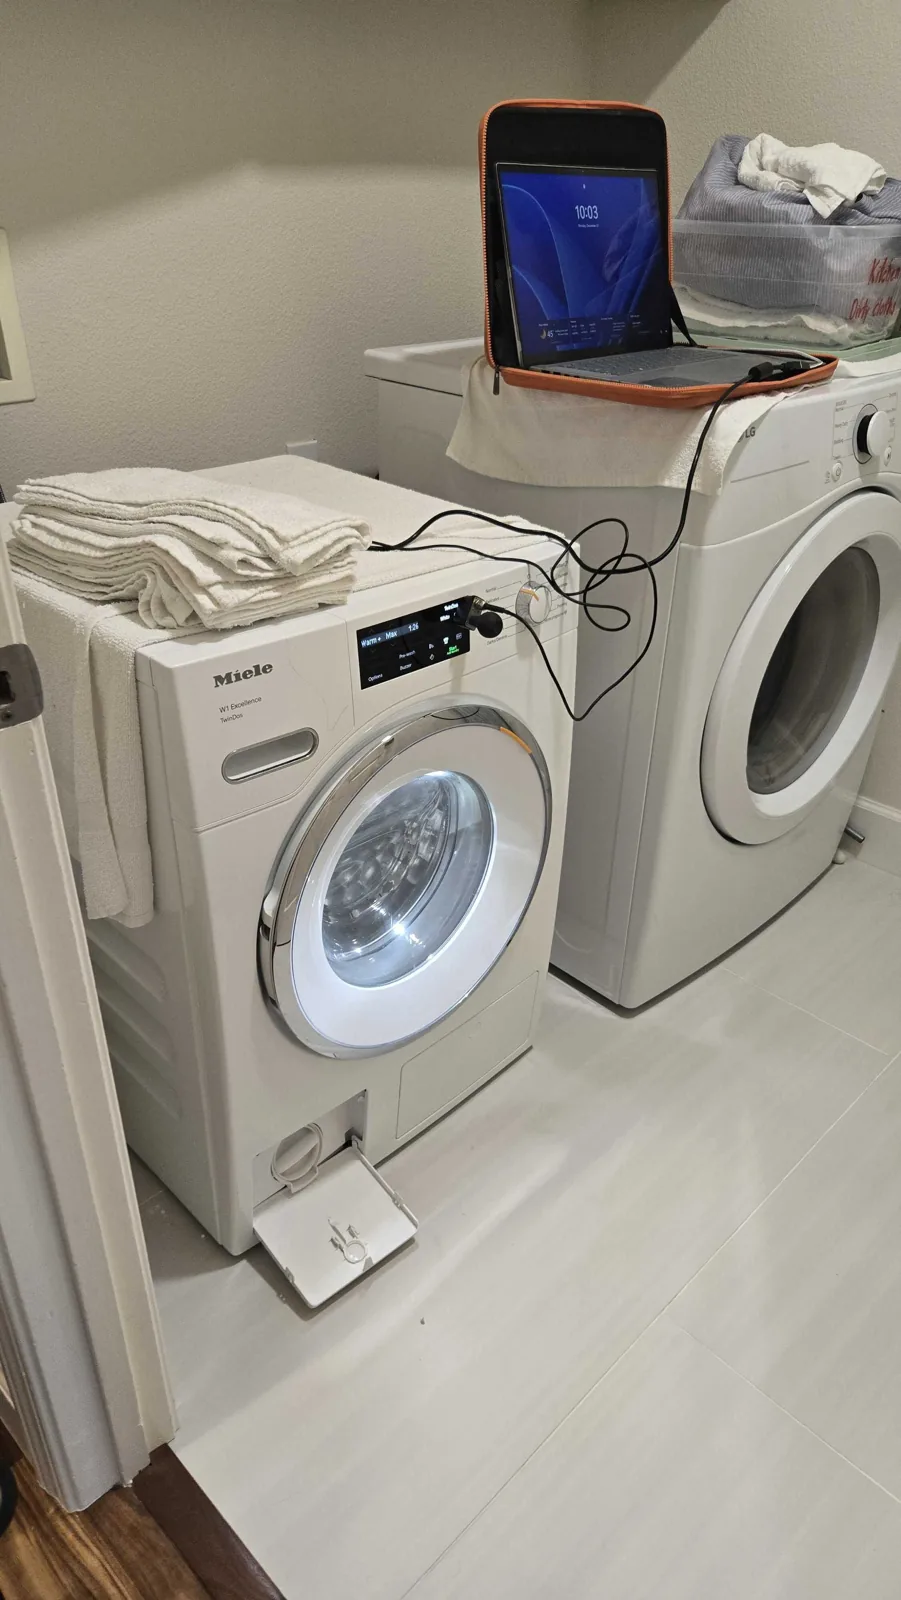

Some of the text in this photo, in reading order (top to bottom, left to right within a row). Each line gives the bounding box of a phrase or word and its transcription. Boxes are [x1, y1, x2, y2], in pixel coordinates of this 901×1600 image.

[574, 204, 599, 220] 10:03
[848, 298, 870, 324] Dirty
[745, 426, 756, 438] LG
[360, 637, 378, 648] Warm
[385, 630, 398, 640] Max
[212, 663, 274, 688] Miele
[367, 673, 384, 682] Options
[218, 696, 262, 713] W1 Excellence
[220, 713, 244, 724] TwinDos
